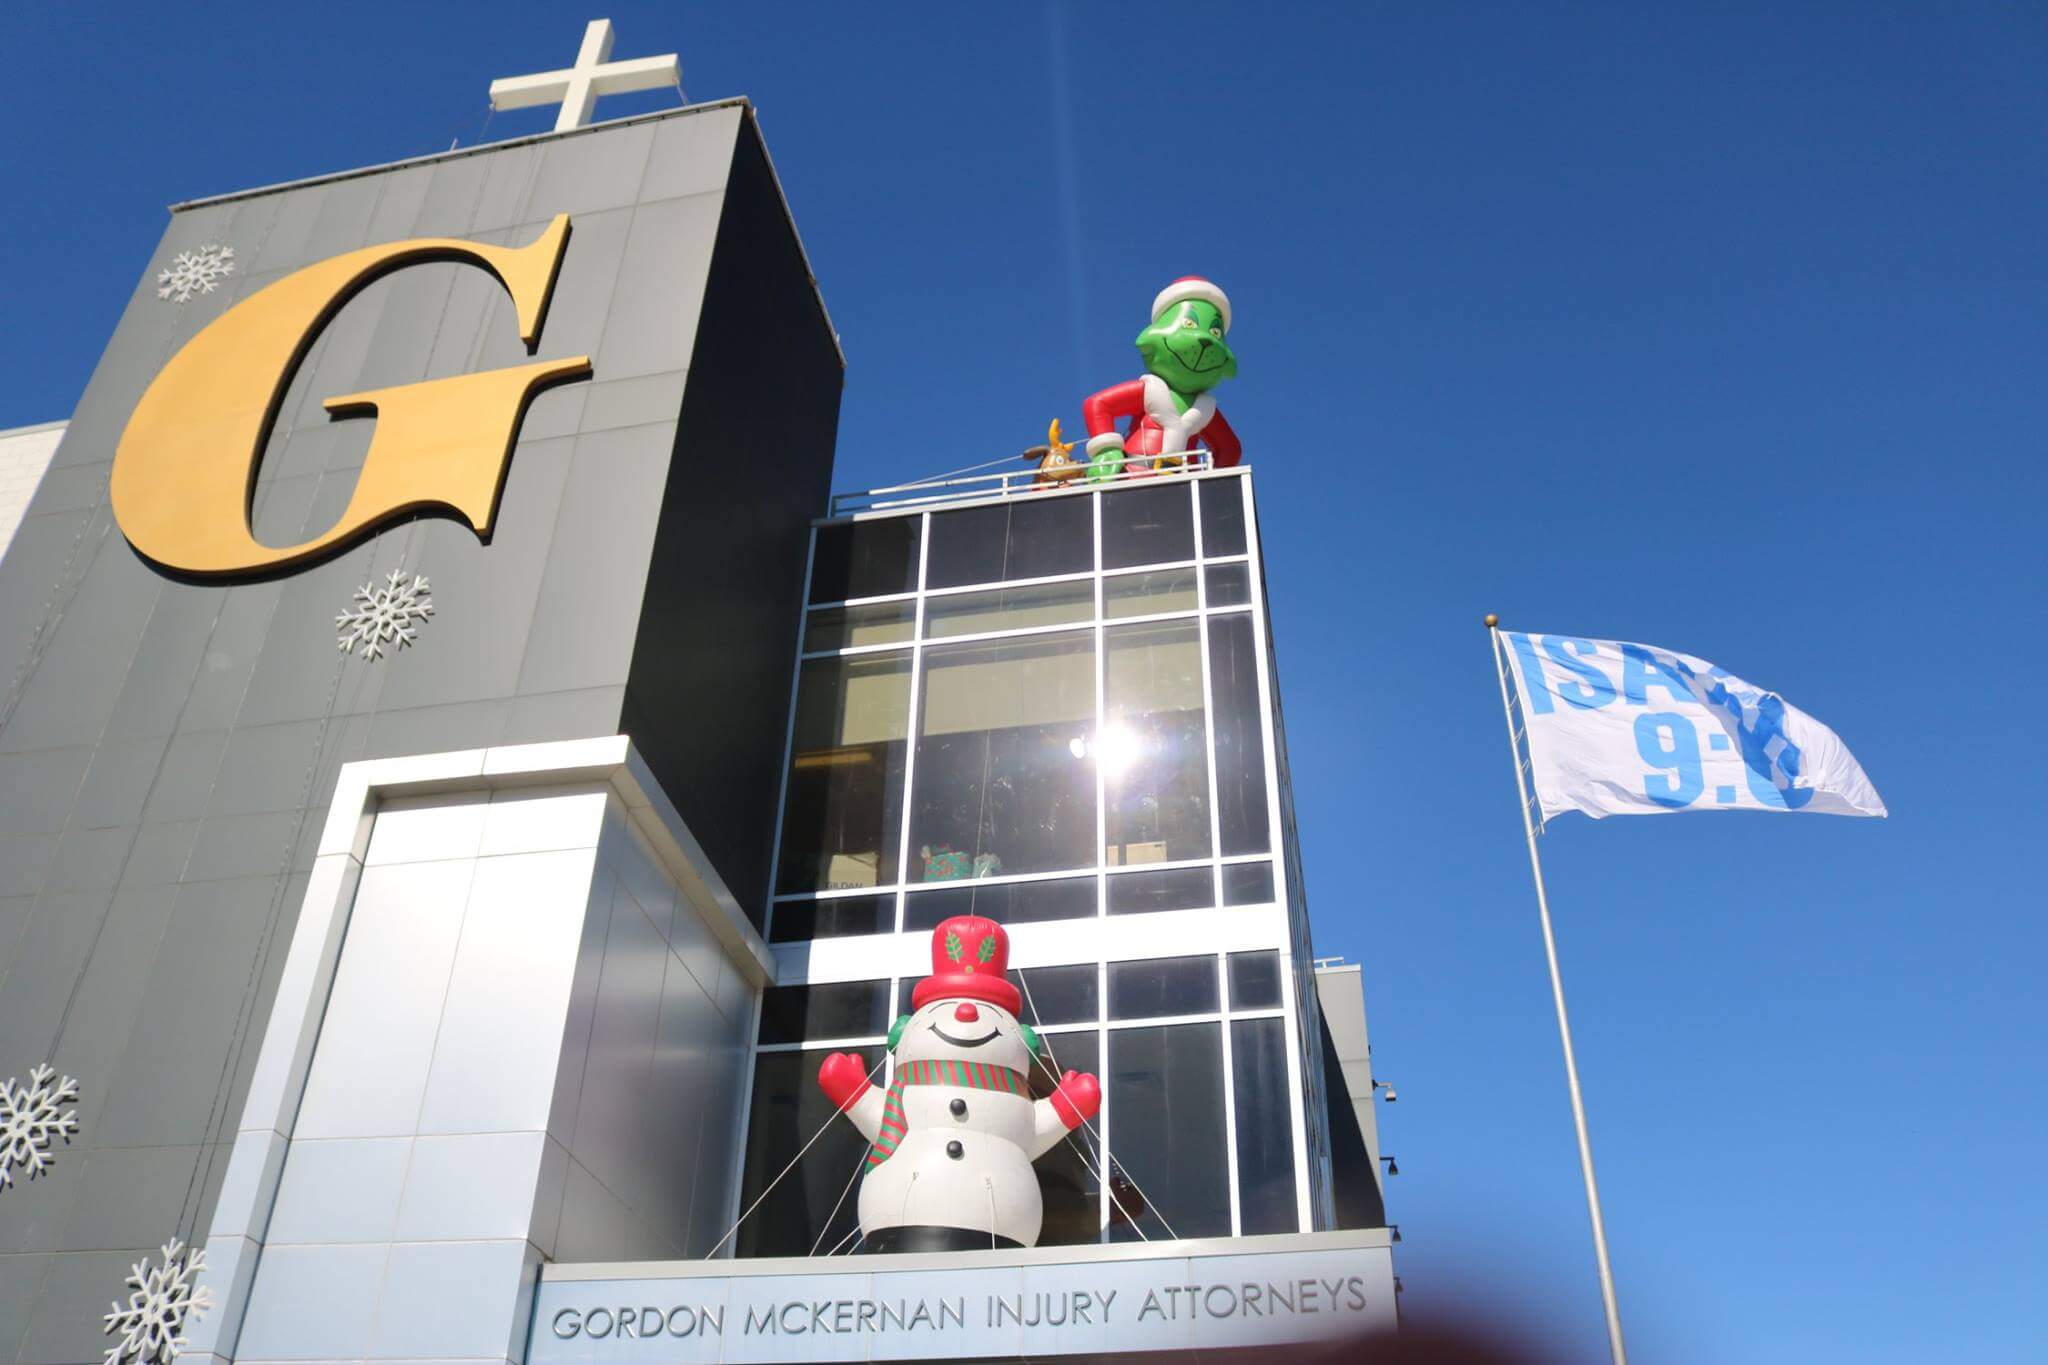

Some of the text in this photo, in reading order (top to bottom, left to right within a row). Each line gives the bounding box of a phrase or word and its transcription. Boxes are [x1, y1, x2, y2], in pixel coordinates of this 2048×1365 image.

[110, 213, 593, 587] G
[552, 1276, 1367, 1339] GORDON MCKERNAN INJURY ATTORNEYS
